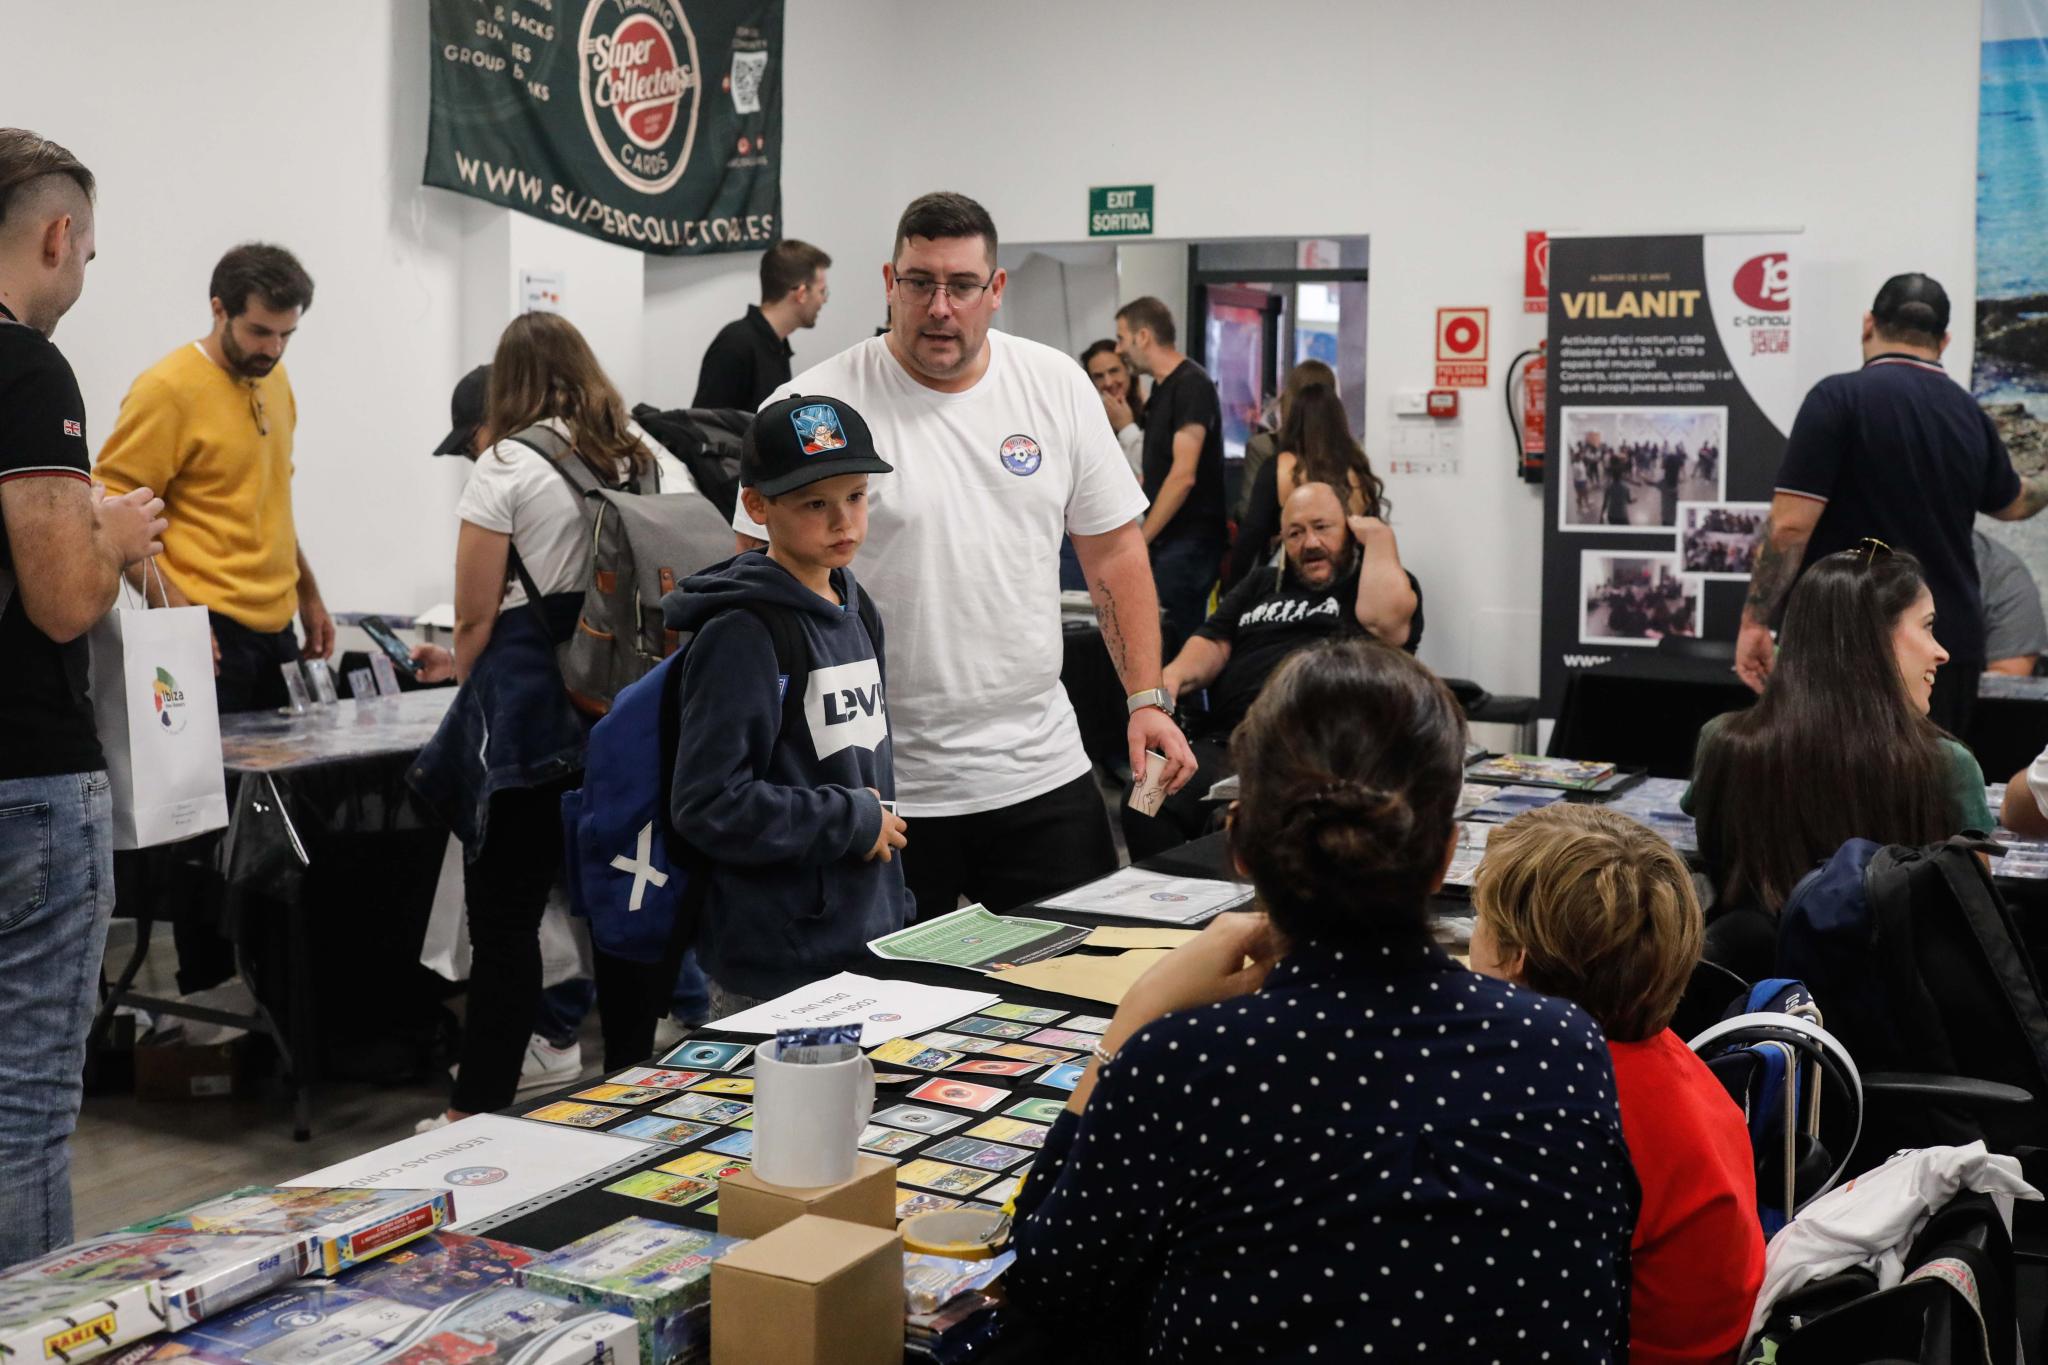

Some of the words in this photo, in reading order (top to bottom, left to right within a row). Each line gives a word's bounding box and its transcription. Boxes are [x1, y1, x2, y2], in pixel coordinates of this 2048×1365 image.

[511, 10, 555, 41] PACKS
[443, 44, 506, 72] GROUP
[593, 35, 656, 80] Super
[595, 64, 691, 108] Collectors
[621, 143, 669, 175] CARDS
[1107, 191, 1136, 209] EXIT
[1092, 212, 1150, 232] SORTIDA
[1560, 290, 1701, 319] VILANIT
[162, 688, 185, 702] Ibiza
[842, 998, 878, 1012] COGE
[401, 1135, 495, 1169] LEONIDAS
